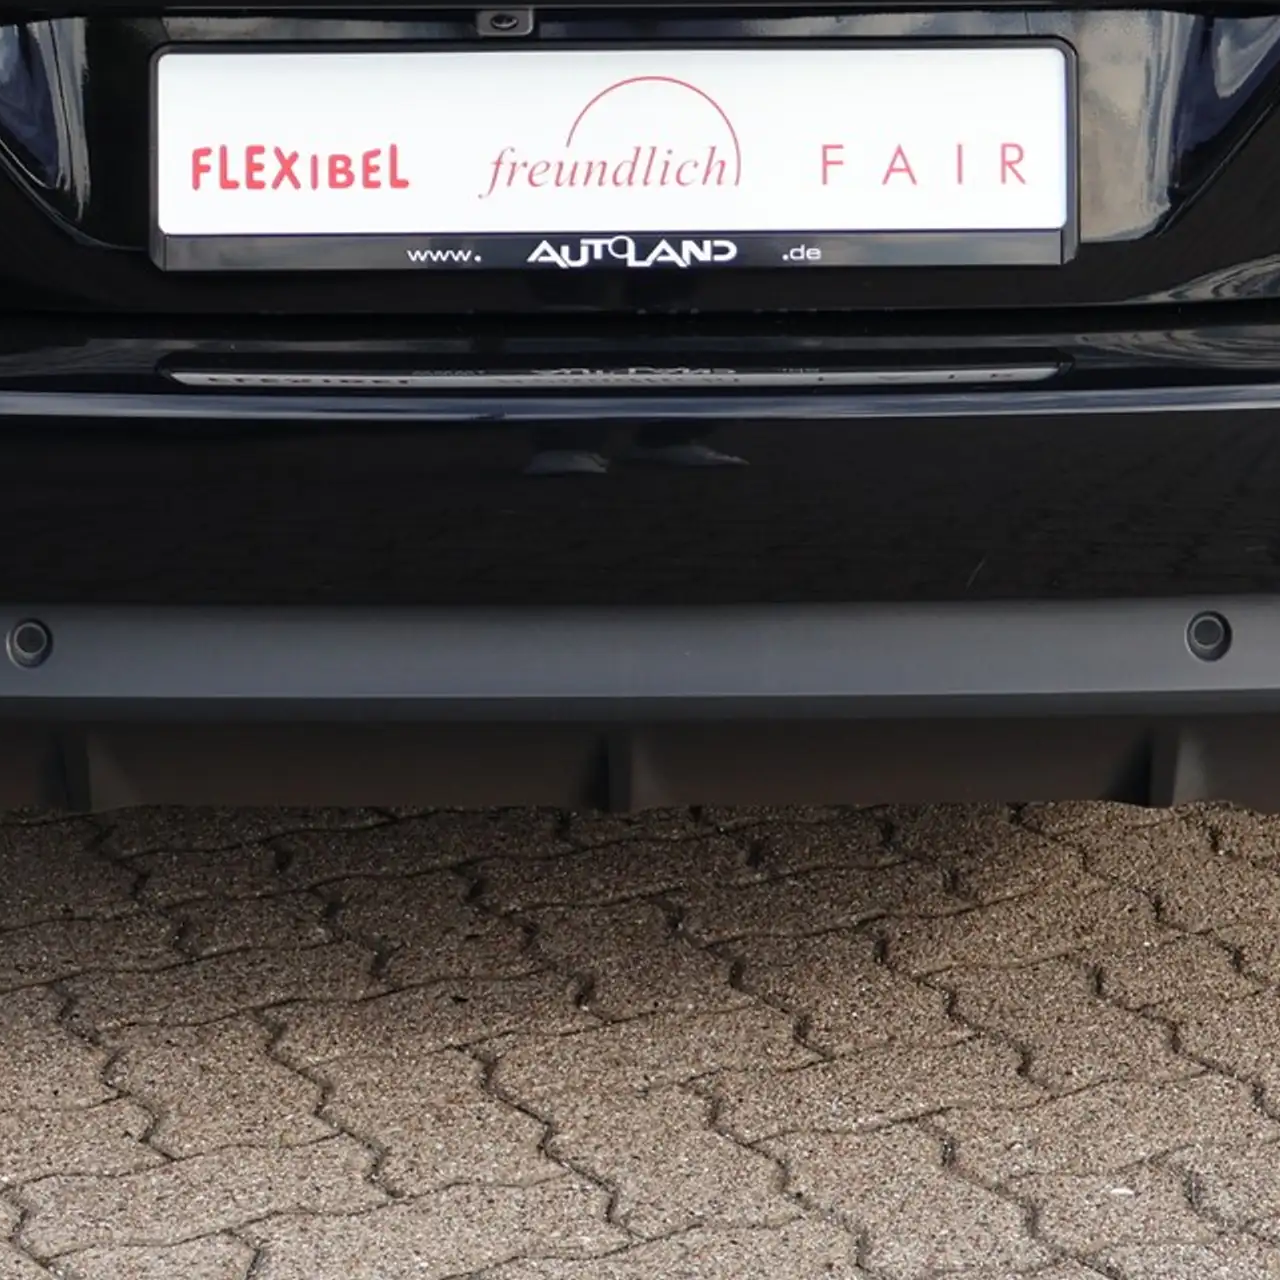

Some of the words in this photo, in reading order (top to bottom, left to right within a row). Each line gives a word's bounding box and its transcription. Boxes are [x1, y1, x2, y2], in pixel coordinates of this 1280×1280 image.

[191, 143, 410, 191] FLEXIBEL
[478, 146, 728, 199] freundlich
[821, 143, 1027, 186] FAIR
[406, 249, 482, 262] www.
[526, 234, 738, 269] AUTOLAND
[781, 243, 823, 261] .de
